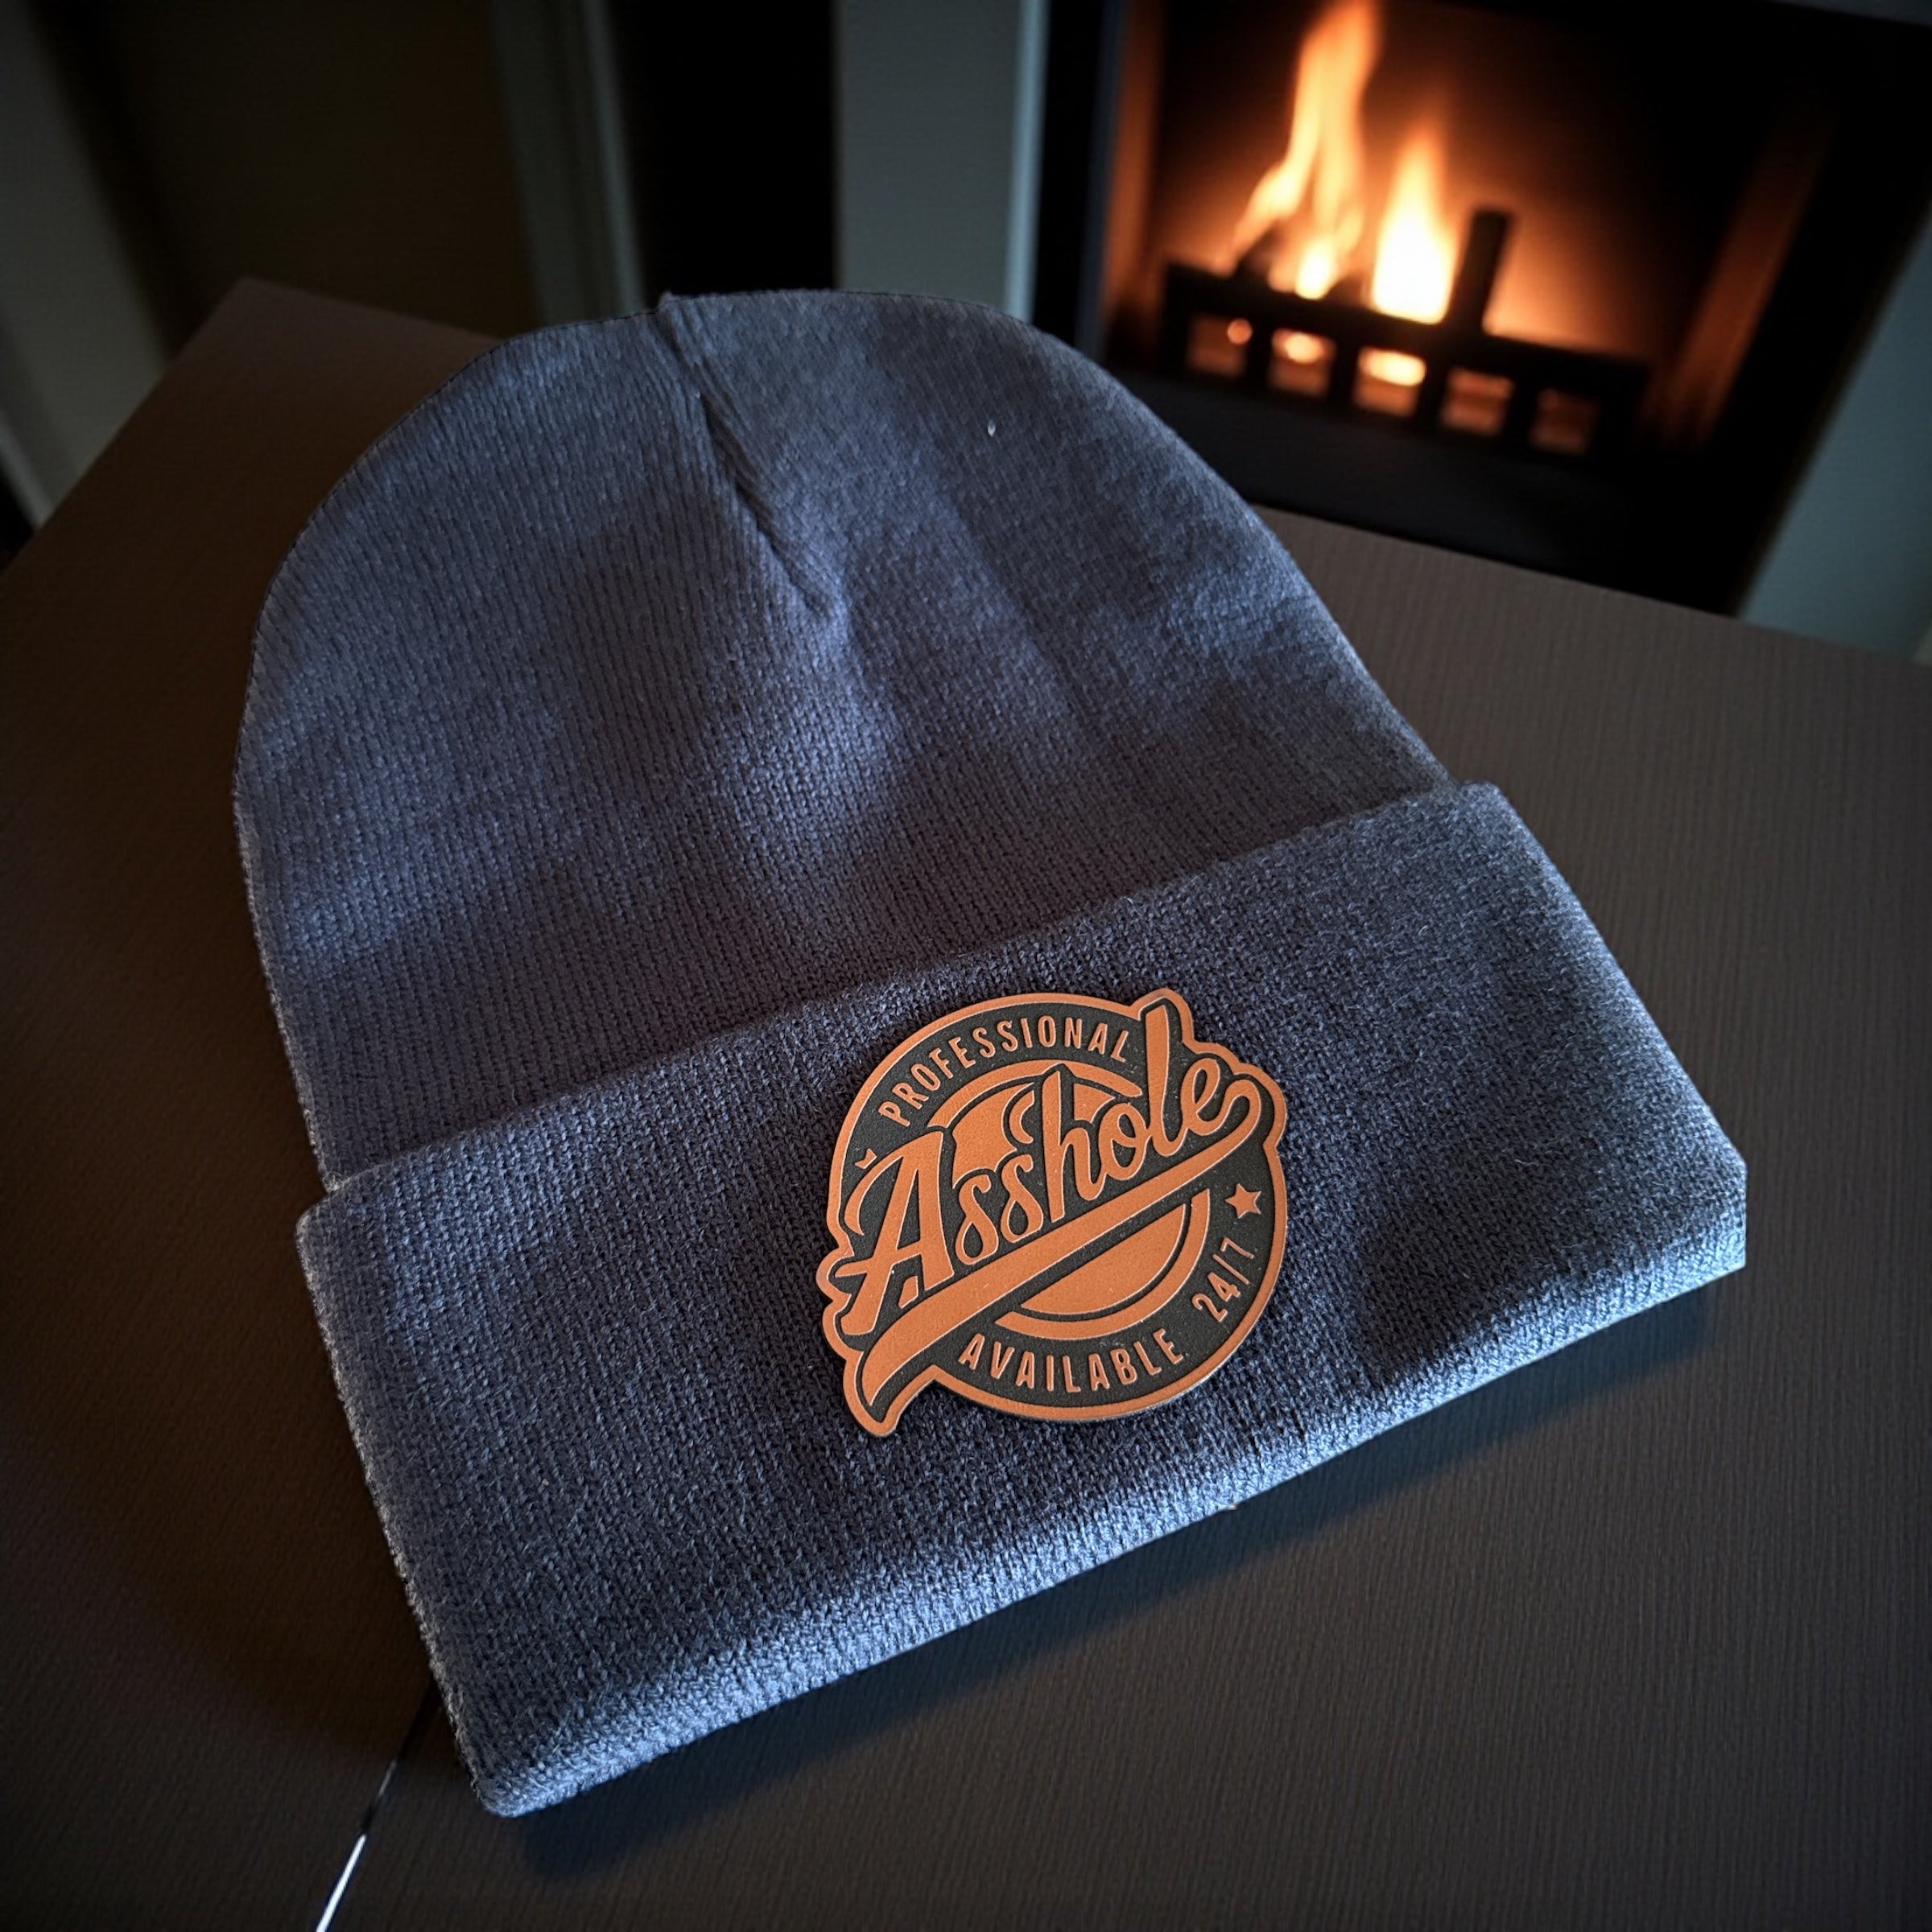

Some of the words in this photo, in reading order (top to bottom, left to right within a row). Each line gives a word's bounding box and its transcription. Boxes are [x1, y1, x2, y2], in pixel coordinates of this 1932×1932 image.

[878, 1015, 1129, 1127] PROFESSIONAL
[835, 1005, 1261, 1336] Asshole
[958, 1328, 1183, 1393] AVAILABLE
[1191, 1237, 1256, 1323] 24/7
